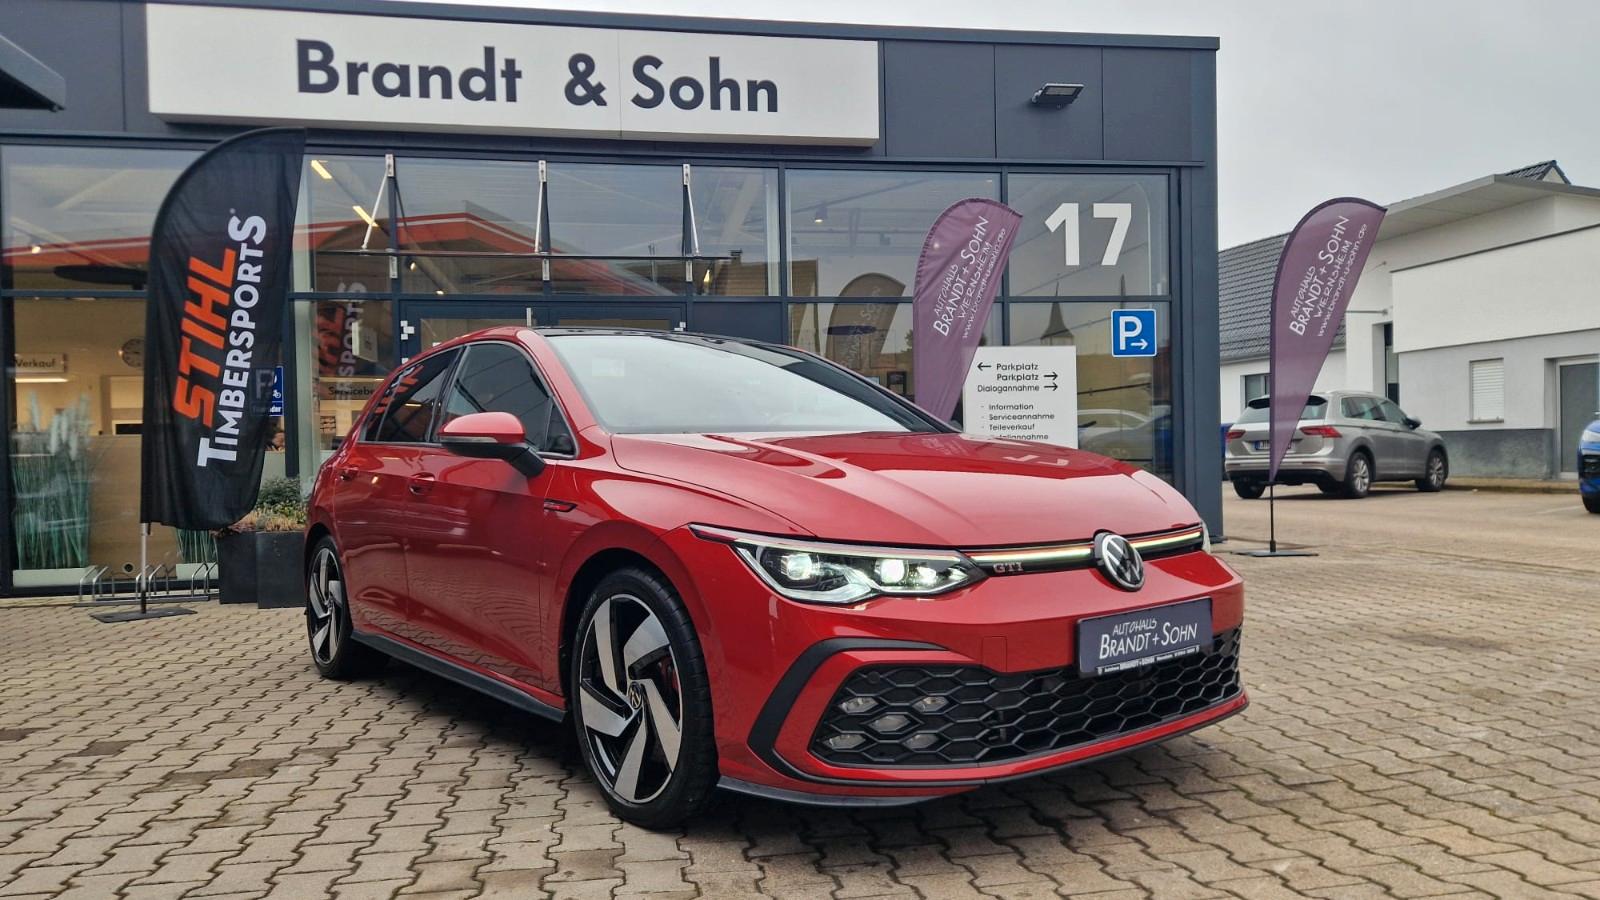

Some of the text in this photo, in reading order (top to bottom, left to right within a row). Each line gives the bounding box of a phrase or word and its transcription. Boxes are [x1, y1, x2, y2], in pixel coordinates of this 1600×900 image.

[297, 39, 777, 112] Brandt & Sohn
[1044, 203, 1132, 265] 17
[933, 215, 989, 337] BRANDT + SOHN
[934, 264, 959, 317] AUTOHAUS
[957, 241, 993, 318] WIERNSHEIM
[1289, 215, 1351, 336] BRANDT + SOHN
[1290, 265, 1316, 318] AUTOHAUS
[1313, 240, 1352, 318] WIERNSHEIM
[173, 248, 237, 429] STIHL
[197, 214, 267, 468] TIMBERSPORTS
[1119, 316, 1143, 351] P
[977, 384, 1040, 394] Dialogannahme
[996, 363, 1039, 372] Parkplatz
[996, 373, 1040, 382] Parkplatz
[988, 403, 1034, 411] Information
[988, 413, 1055, 421] Serviceannahme
[992, 561, 1024, 573] GTI
[1099, 632, 1152, 660] BRANDT
[1152, 633, 1160, 645] +
[1161, 622, 1198, 646] SOHN
[1112, 618, 1157, 636] AUTOHAUS
